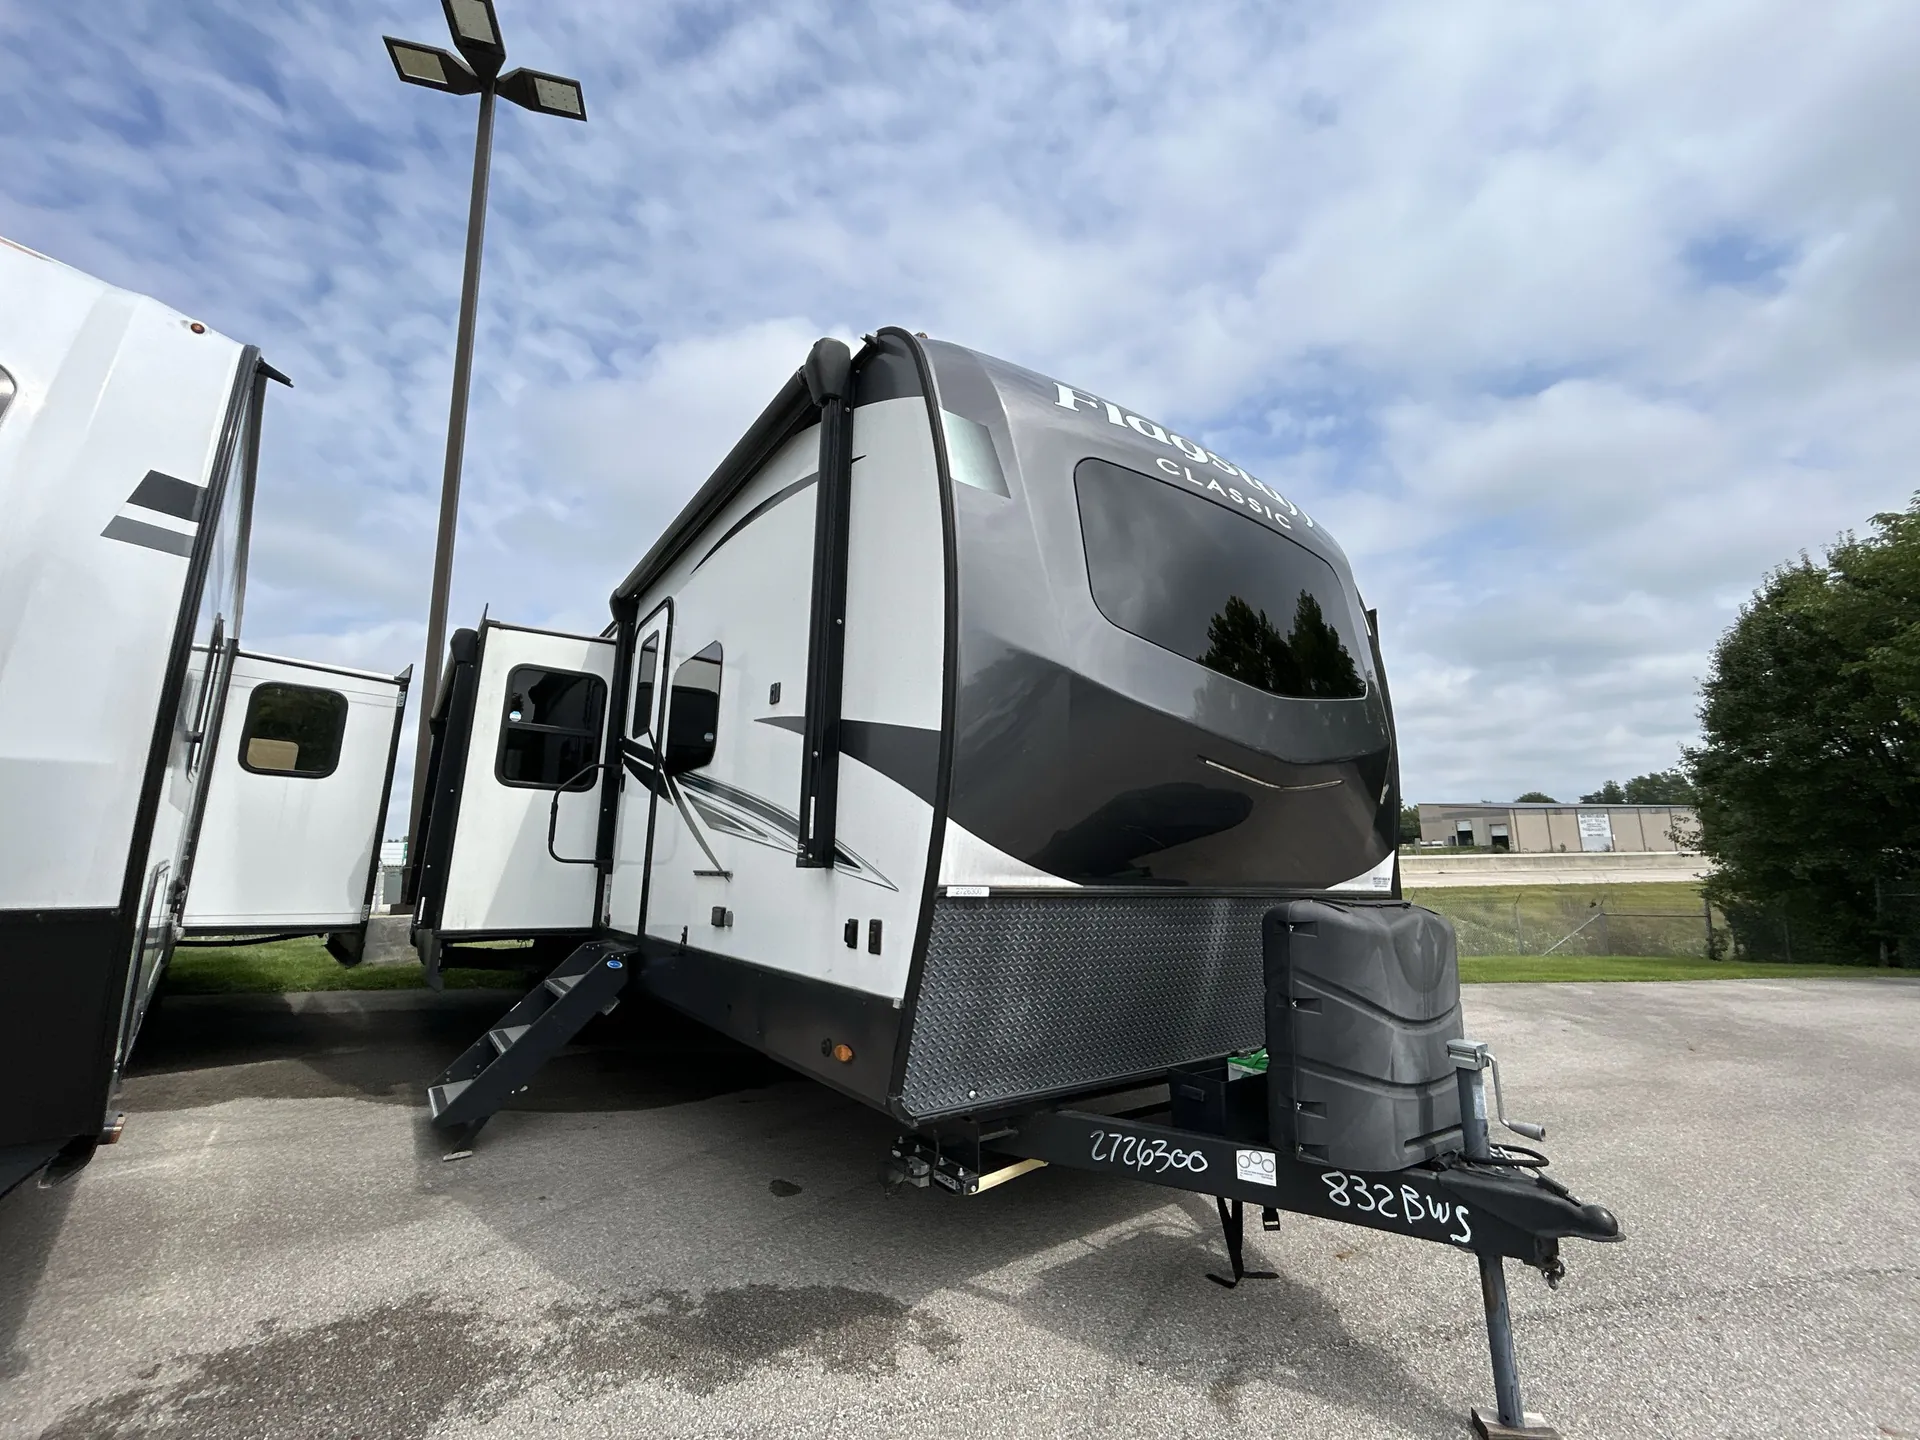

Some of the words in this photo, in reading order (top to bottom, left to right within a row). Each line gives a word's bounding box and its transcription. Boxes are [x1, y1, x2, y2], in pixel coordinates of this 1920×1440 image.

[1053, 381, 1314, 529] Flagsta
[1156, 457, 1292, 530] CLASSIC
[1089, 1130, 1208, 1174] 2726300
